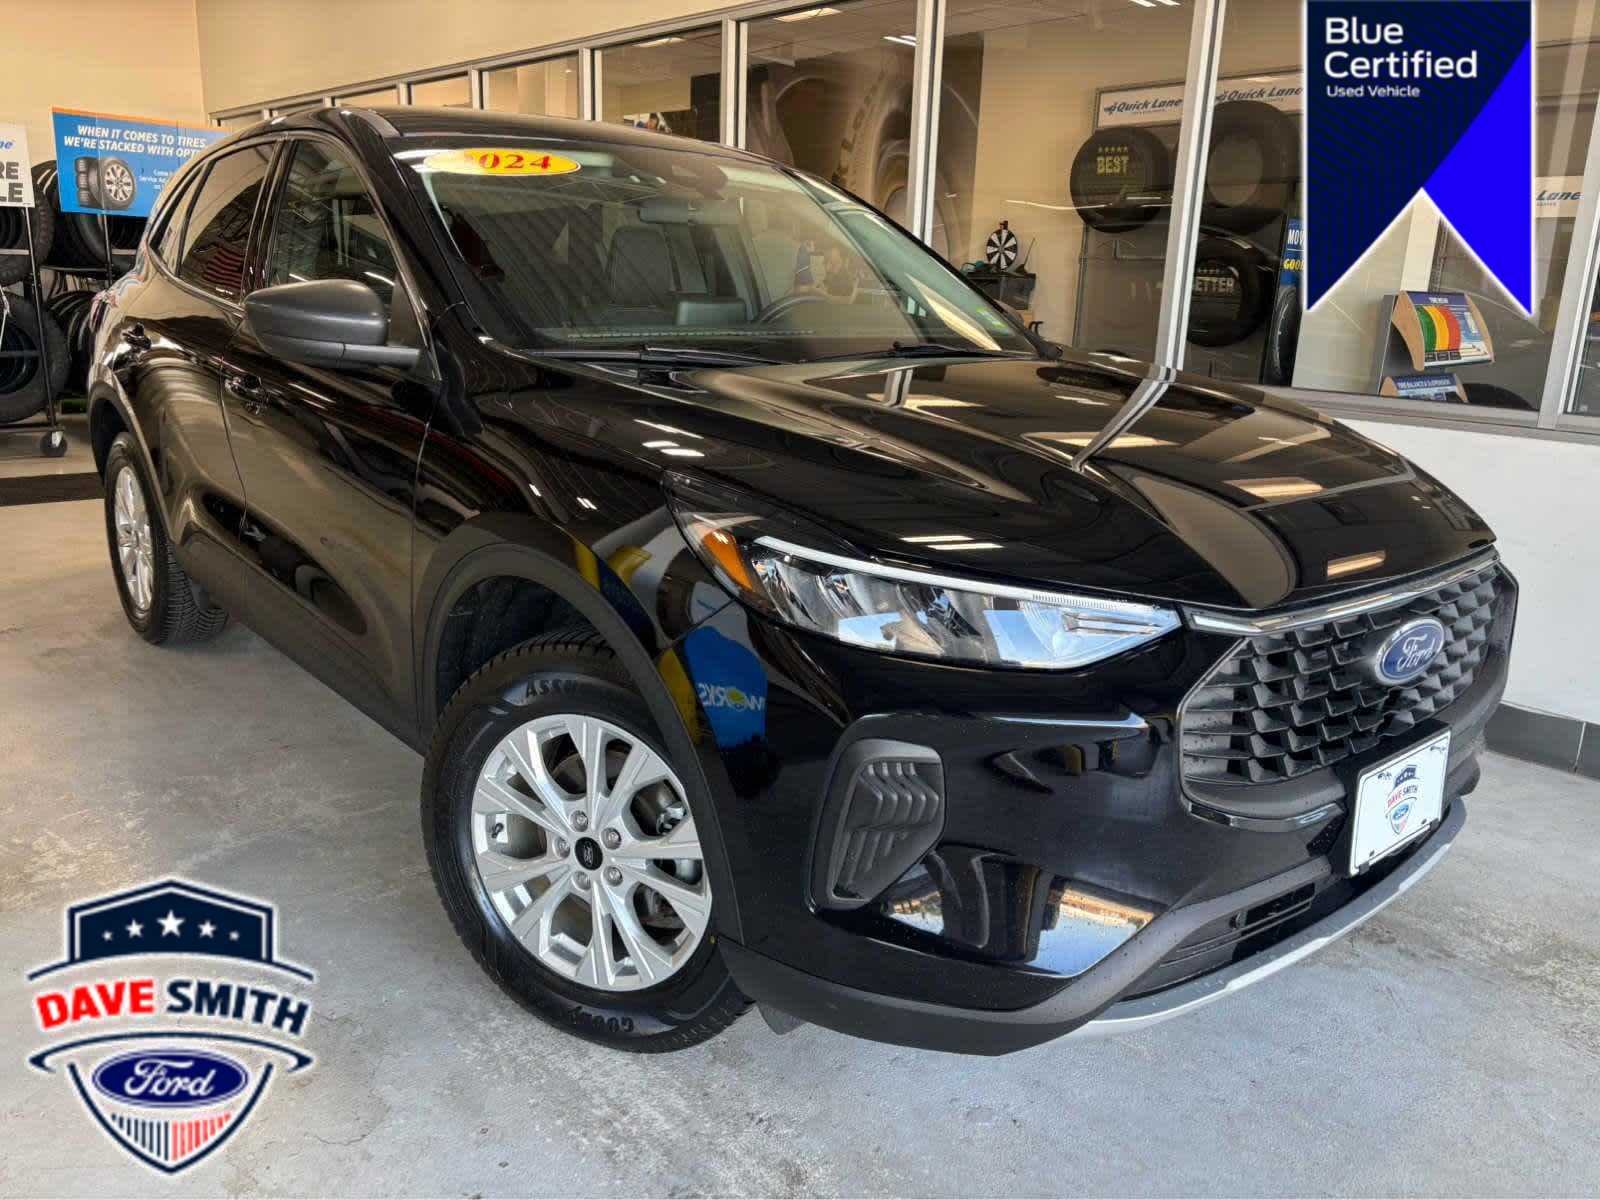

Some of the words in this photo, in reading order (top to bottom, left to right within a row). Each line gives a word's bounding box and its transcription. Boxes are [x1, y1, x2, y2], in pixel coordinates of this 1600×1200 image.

[1226, 88, 1265, 101] Quick
[1268, 86, 1303, 98] Lane
[1116, 99, 1150, 113] Quick
[1151, 98, 1182, 109] Lane
[77, 125, 109, 138] WHEN
[111, 129, 121, 140] IT
[123, 130, 158, 144] COMES
[161, 133, 175, 145] TO
[63, 136, 97, 149] WE'RE
[98, 139, 145, 153] STACKED
[147, 145, 174, 157] WITH
[464, 152, 552, 169] 024
[1096, 155, 1130, 174] BEST
[1535, 190, 1584, 201] Lane
[1194, 275, 1235, 294] ETTER
[1397, 633, 1436, 672] Ford
